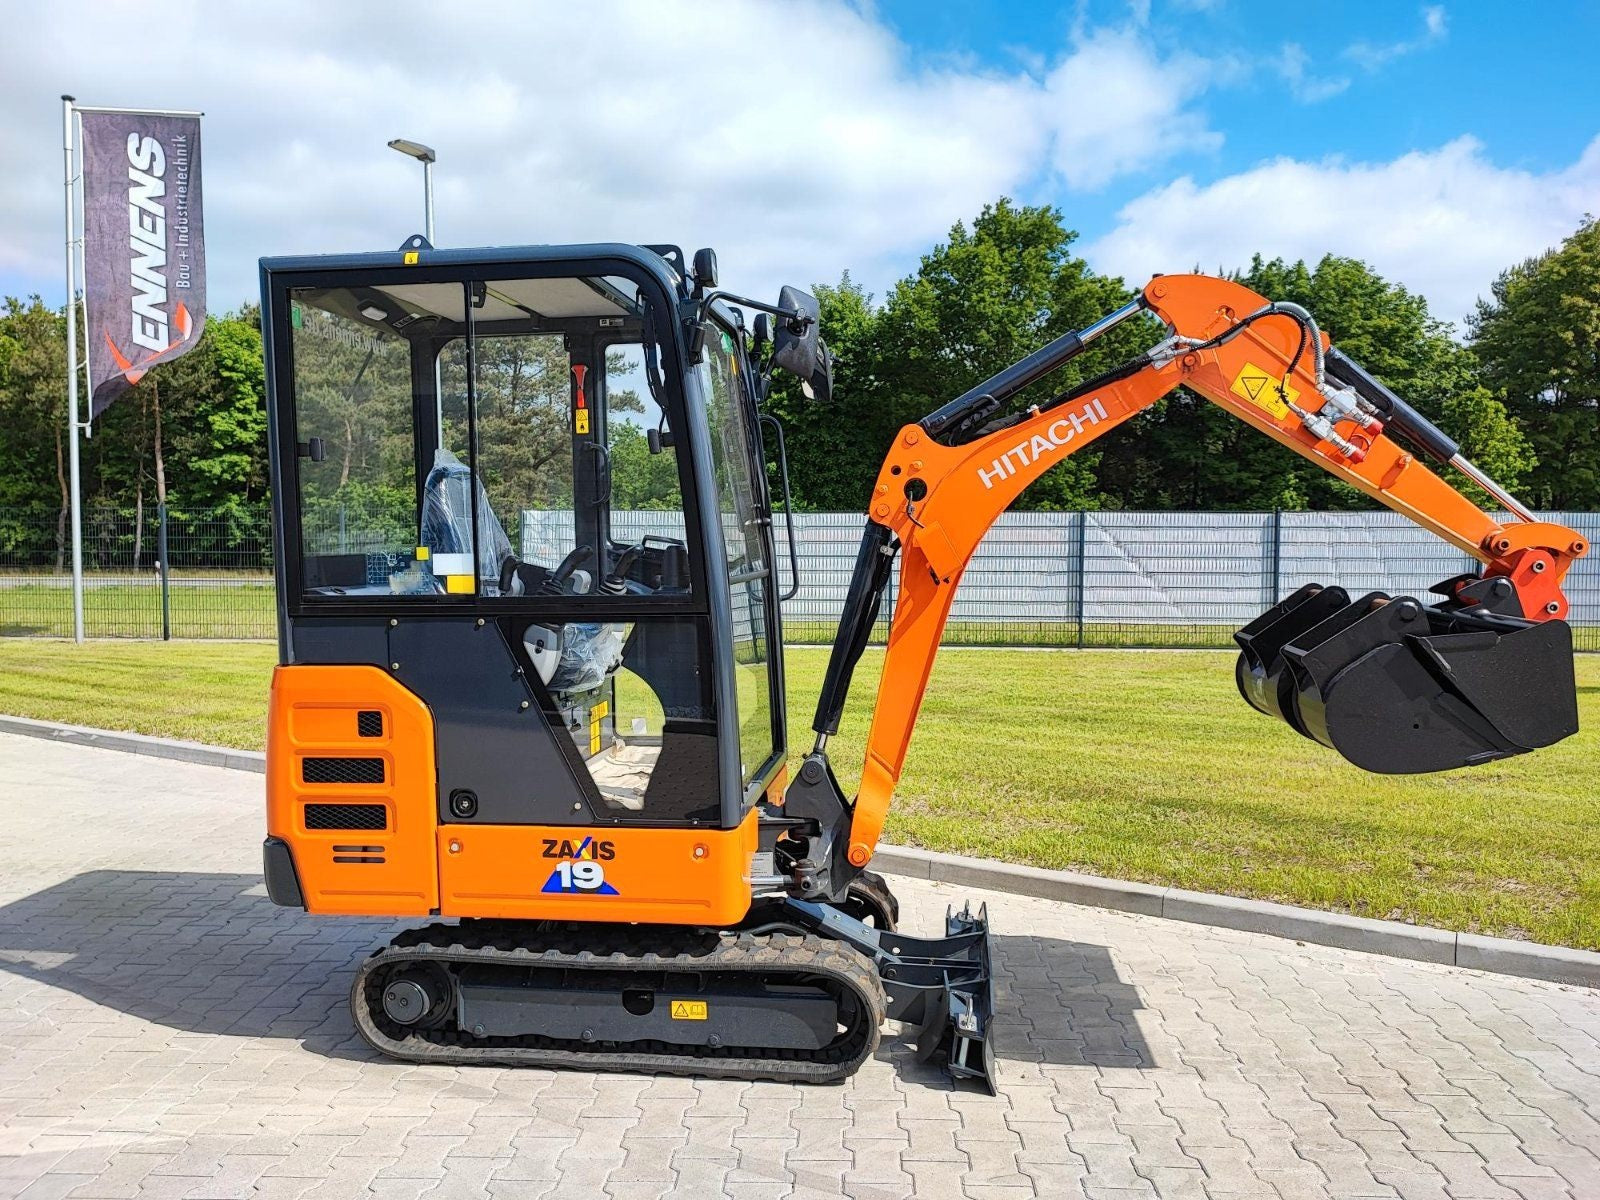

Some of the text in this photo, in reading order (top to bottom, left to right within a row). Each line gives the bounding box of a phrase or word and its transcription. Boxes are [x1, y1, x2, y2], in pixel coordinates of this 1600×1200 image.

[171, 134, 189, 247] Industrietechnik
[126, 132, 169, 353] ENNENS
[176, 264, 190, 289] Bau
[977, 398, 1108, 489] HITACHI
[542, 836, 616, 861] ZAXIS
[556, 860, 605, 893] 19
